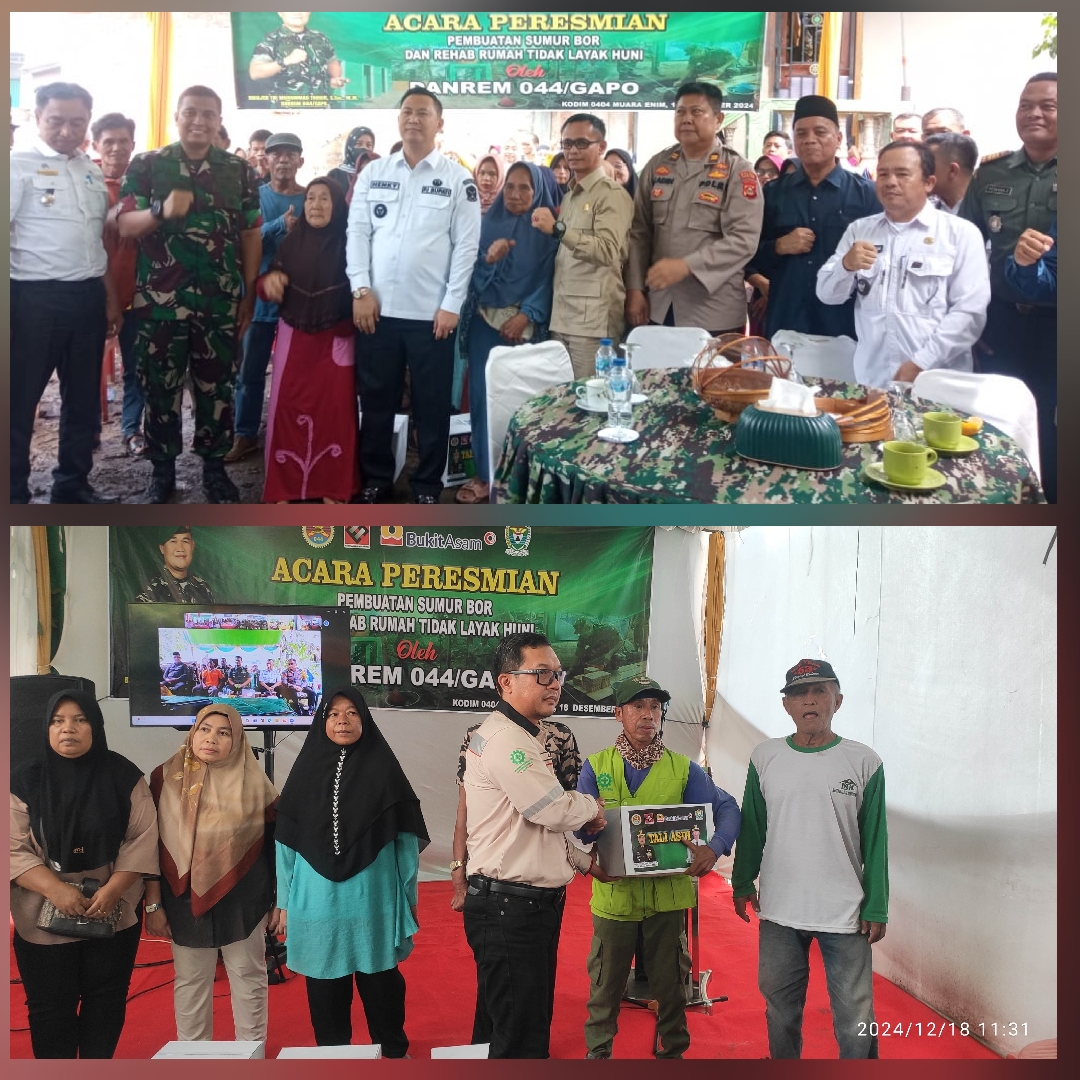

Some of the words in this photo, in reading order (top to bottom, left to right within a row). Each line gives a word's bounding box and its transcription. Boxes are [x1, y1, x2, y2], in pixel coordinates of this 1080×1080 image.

[382, 13, 482, 31] ACARA
[489, 13, 667, 31] PERESMIAN
[447, 35, 521, 46] PEMBUATAN
[525, 35, 570, 46] SUMUR
[574, 35, 599, 46] BOR
[405, 50, 430, 60] DAN
[434, 50, 475, 60] REHAB
[479, 50, 523, 60] RUMAH
[527, 50, 565, 60] TIDAK
[568, 50, 608, 60] LAYAK
[612, 50, 644, 60] HUNI
[505, 64, 545, 78] Oleh
[520, 81, 639, 95] 044/GAPO
[372, 181, 397, 189] HENKY
[405, 531, 483, 551] BukitAsam
[271, 557, 373, 586] ACARA
[380, 562, 560, 596] PERESMIAN
[337, 592, 414, 612] PEMBUATAN
[417, 596, 463, 615] SUMUR
[466, 599, 493, 616] BOR
[370, 617, 415, 633] RUMAH
[419, 618, 457, 636] TIDAK
[460, 620, 500, 637] LAYAK
[396, 639, 438, 661] Oleh
[452, 698, 479, 708] KODIM
[648, 832, 668, 844] TALI
[670, 830, 691, 842] ASIH
